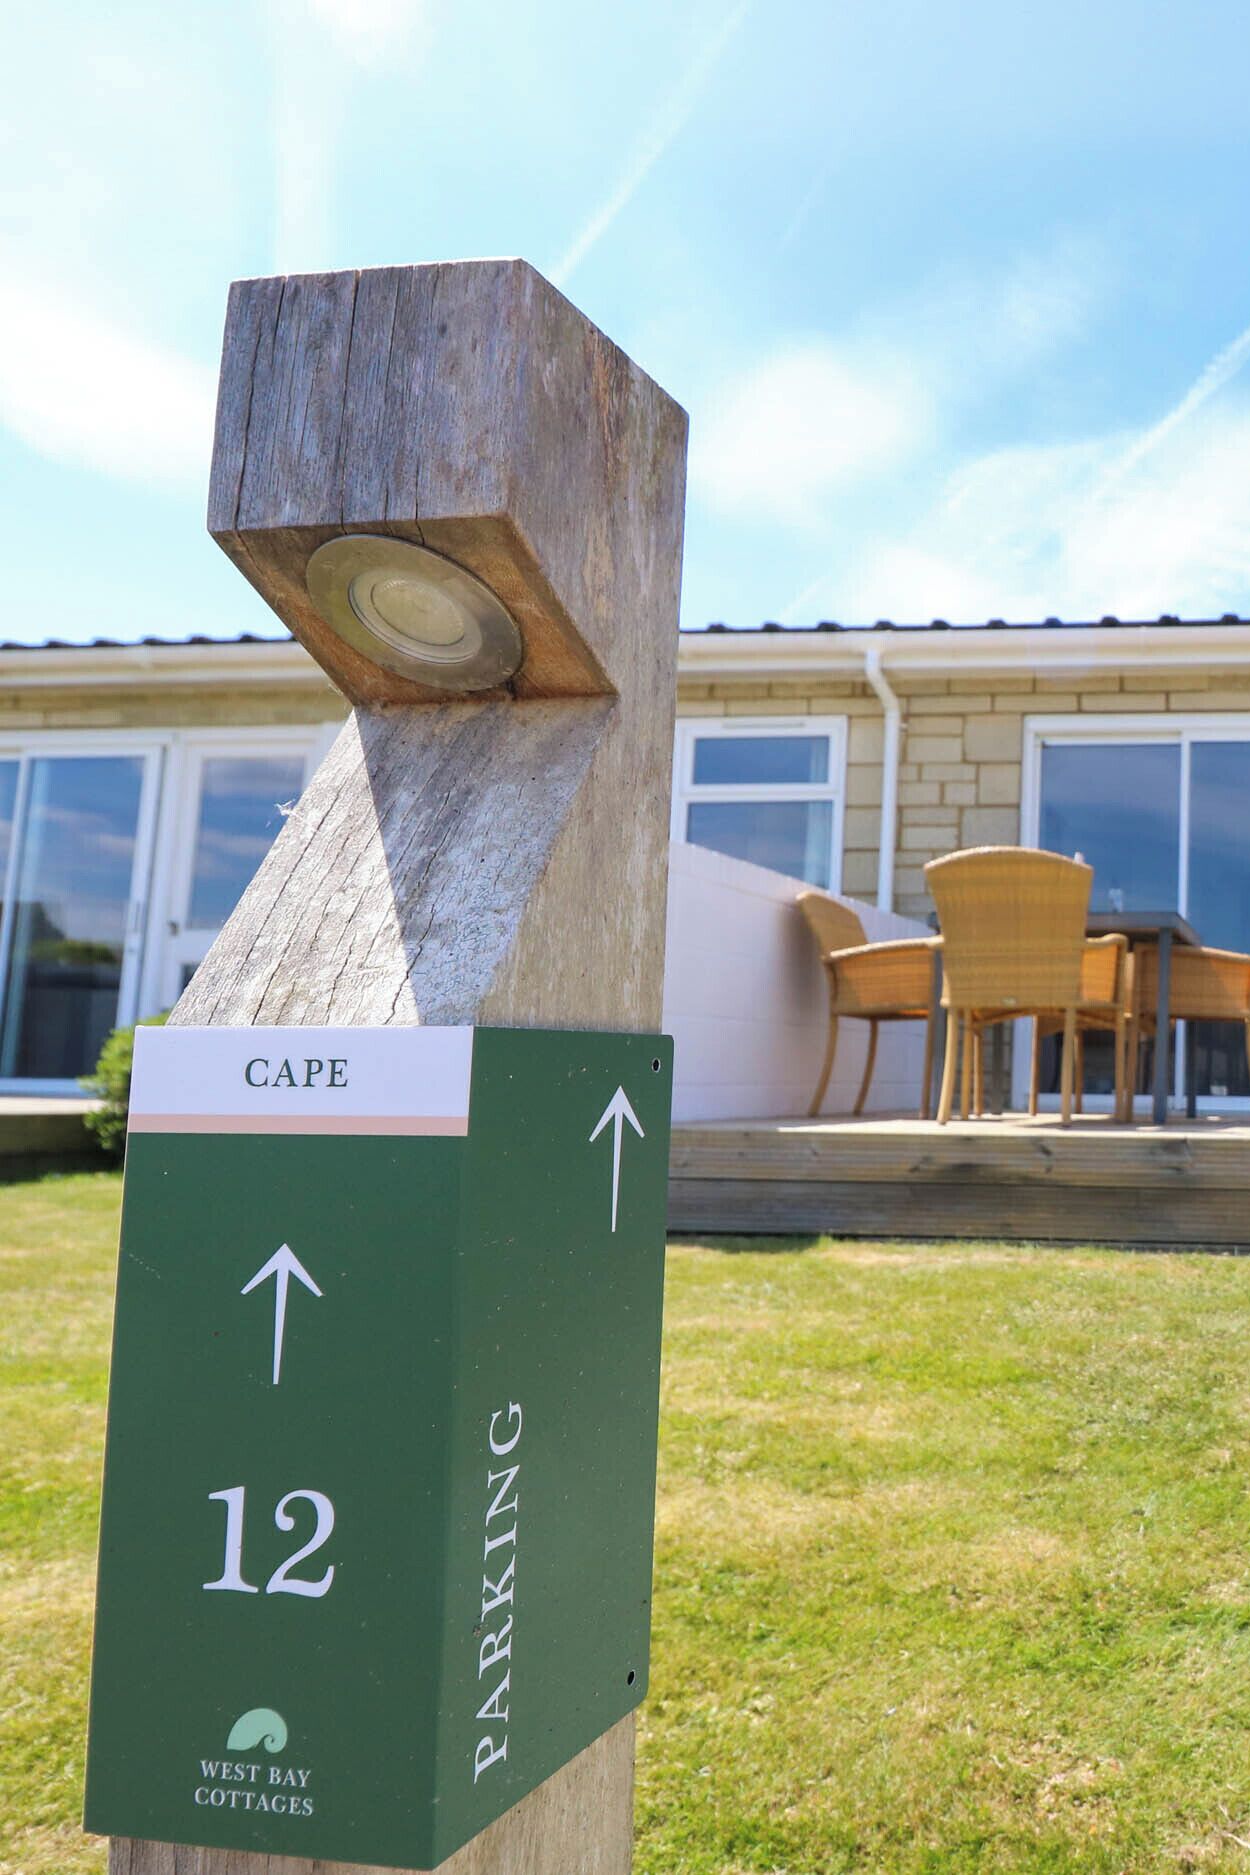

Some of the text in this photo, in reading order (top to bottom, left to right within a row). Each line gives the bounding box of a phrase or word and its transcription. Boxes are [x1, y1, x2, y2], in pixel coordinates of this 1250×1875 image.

[245, 1058, 348, 1089] CAPE
[203, 1486, 336, 1599] 12
[473, 1401, 524, 1784] PARKING
[200, 1760, 312, 1788] WEST BAY
[194, 1786, 314, 1817] COTTAGES
